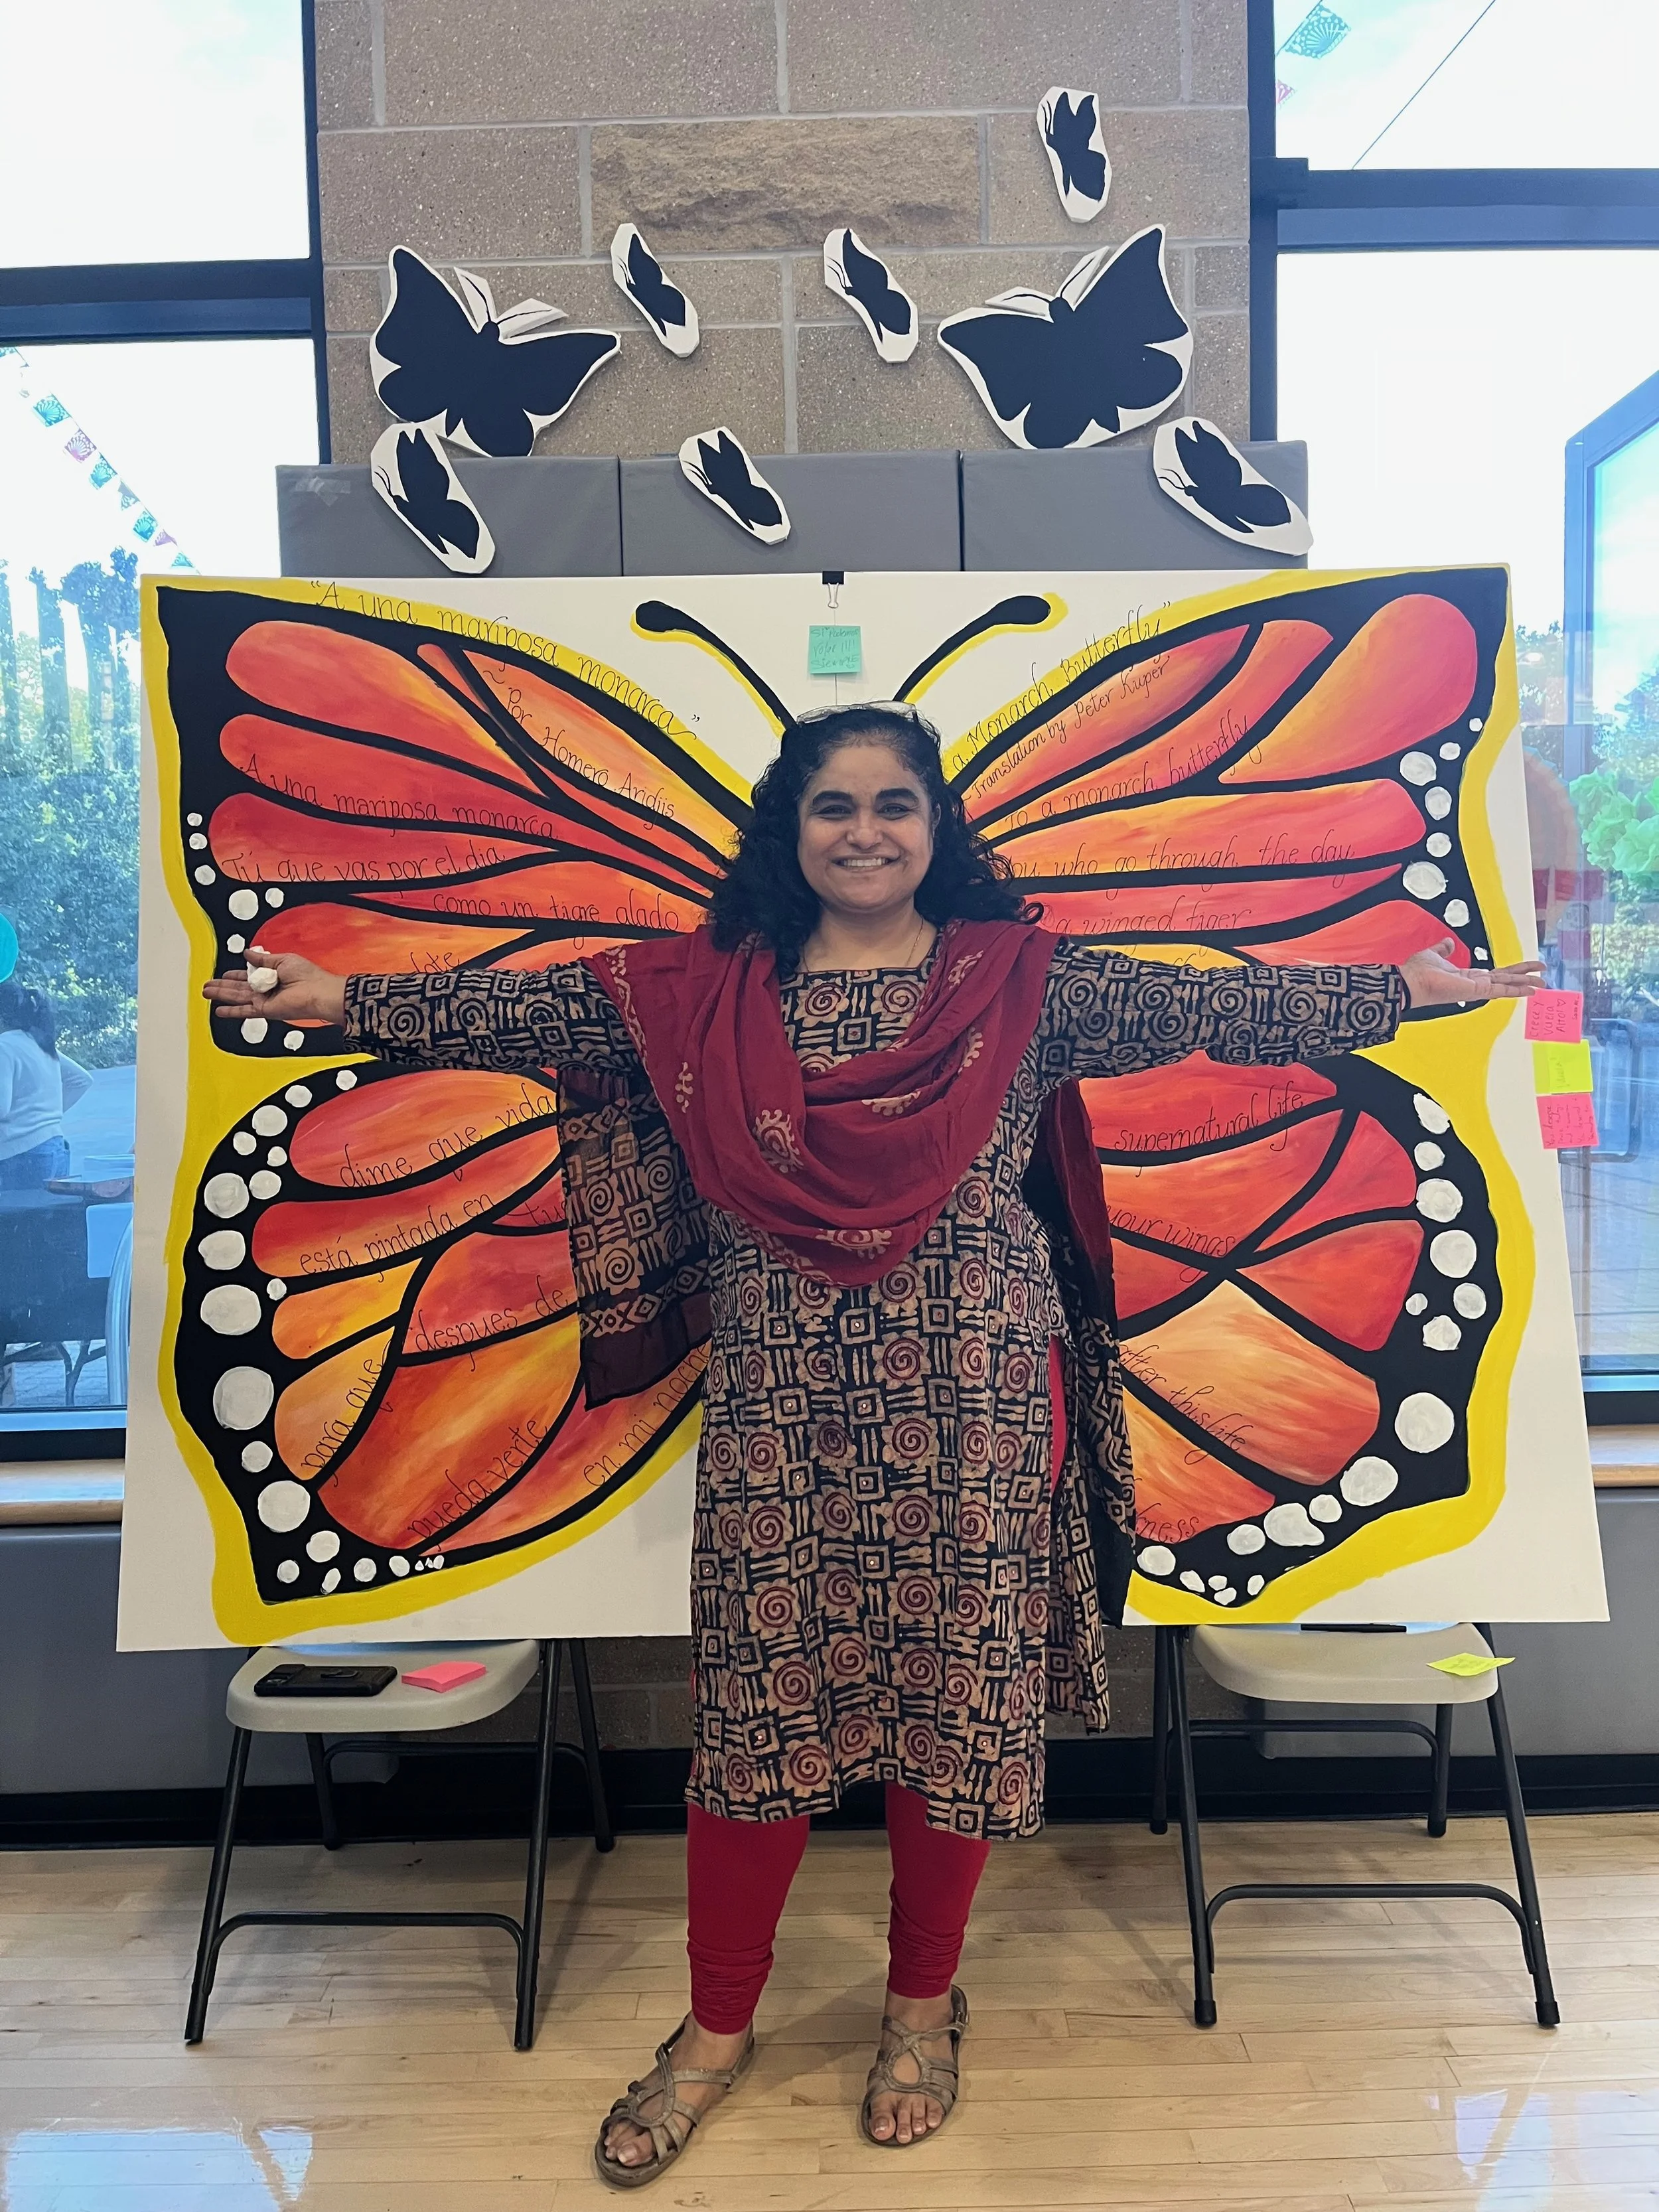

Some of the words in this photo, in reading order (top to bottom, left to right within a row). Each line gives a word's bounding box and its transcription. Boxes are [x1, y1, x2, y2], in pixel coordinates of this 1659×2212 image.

[358, 595, 418, 625] una
[437, 610, 559, 672] mariposa
[967, 662, 1054, 755] Monarch
[972, 733, 1046, 800] Translation
[1046, 720, 1066, 744] by
[1074, 688, 1114, 729] Peter
[1120, 655, 1170, 699] Kuper
[240, 754, 266, 785] A
[270, 774, 322, 806] una
[334, 794, 443, 838] mariposa
[453, 808, 559, 840] monarca
[507, 688, 532, 724] Por
[541, 727, 609, 786] Homero
[618, 773, 675, 830] Aridjis
[1042, 800, 1056, 818] a
[1064, 761, 1158, 811] monarch
[1168, 709, 1262, 784] butterfly
[222, 851, 264, 883] Tú
[277, 859, 326, 882] que
[334, 860, 381, 881] vas
[388, 857, 428, 899] por
[436, 846, 461, 876] el
[1054, 842, 1098, 877] who
[1147, 835, 1238, 892] through
[1259, 833, 1299, 864] the
[1311, 829, 1355, 889] day
[433, 893, 491, 917] como
[500, 901, 538, 919] un
[550, 895, 600, 950] tigre
[615, 889, 679, 931] alado
[1055, 918, 1072, 933] a
[1083, 895, 1186, 956] winged
[1186, 901, 1252, 956] tiger
[340, 1143, 413, 1188] dime
[429, 1126, 483, 1182] que
[495, 1082, 556, 1128] vida
[1114, 1093, 1259, 1177] supernatural
[1268, 1080, 1304, 1151] life
[301, 1236, 358, 1274] está
[365, 1205, 459, 1283] pintada
[463, 1194, 496, 1218] en
[1164, 1223, 1235, 1283] wings
[415, 1309, 518, 1372] despues
[536, 1275, 568, 1317] de
[301, 1419, 356, 1487] para
[346, 1339, 394, 1412] que
[583, 1453, 622, 1487] en
[618, 1414, 657, 1455] mi
[1169, 1386, 1214, 1428] this
[407, 1469, 494, 1552] pueda
[487, 1418, 548, 1484] verte
